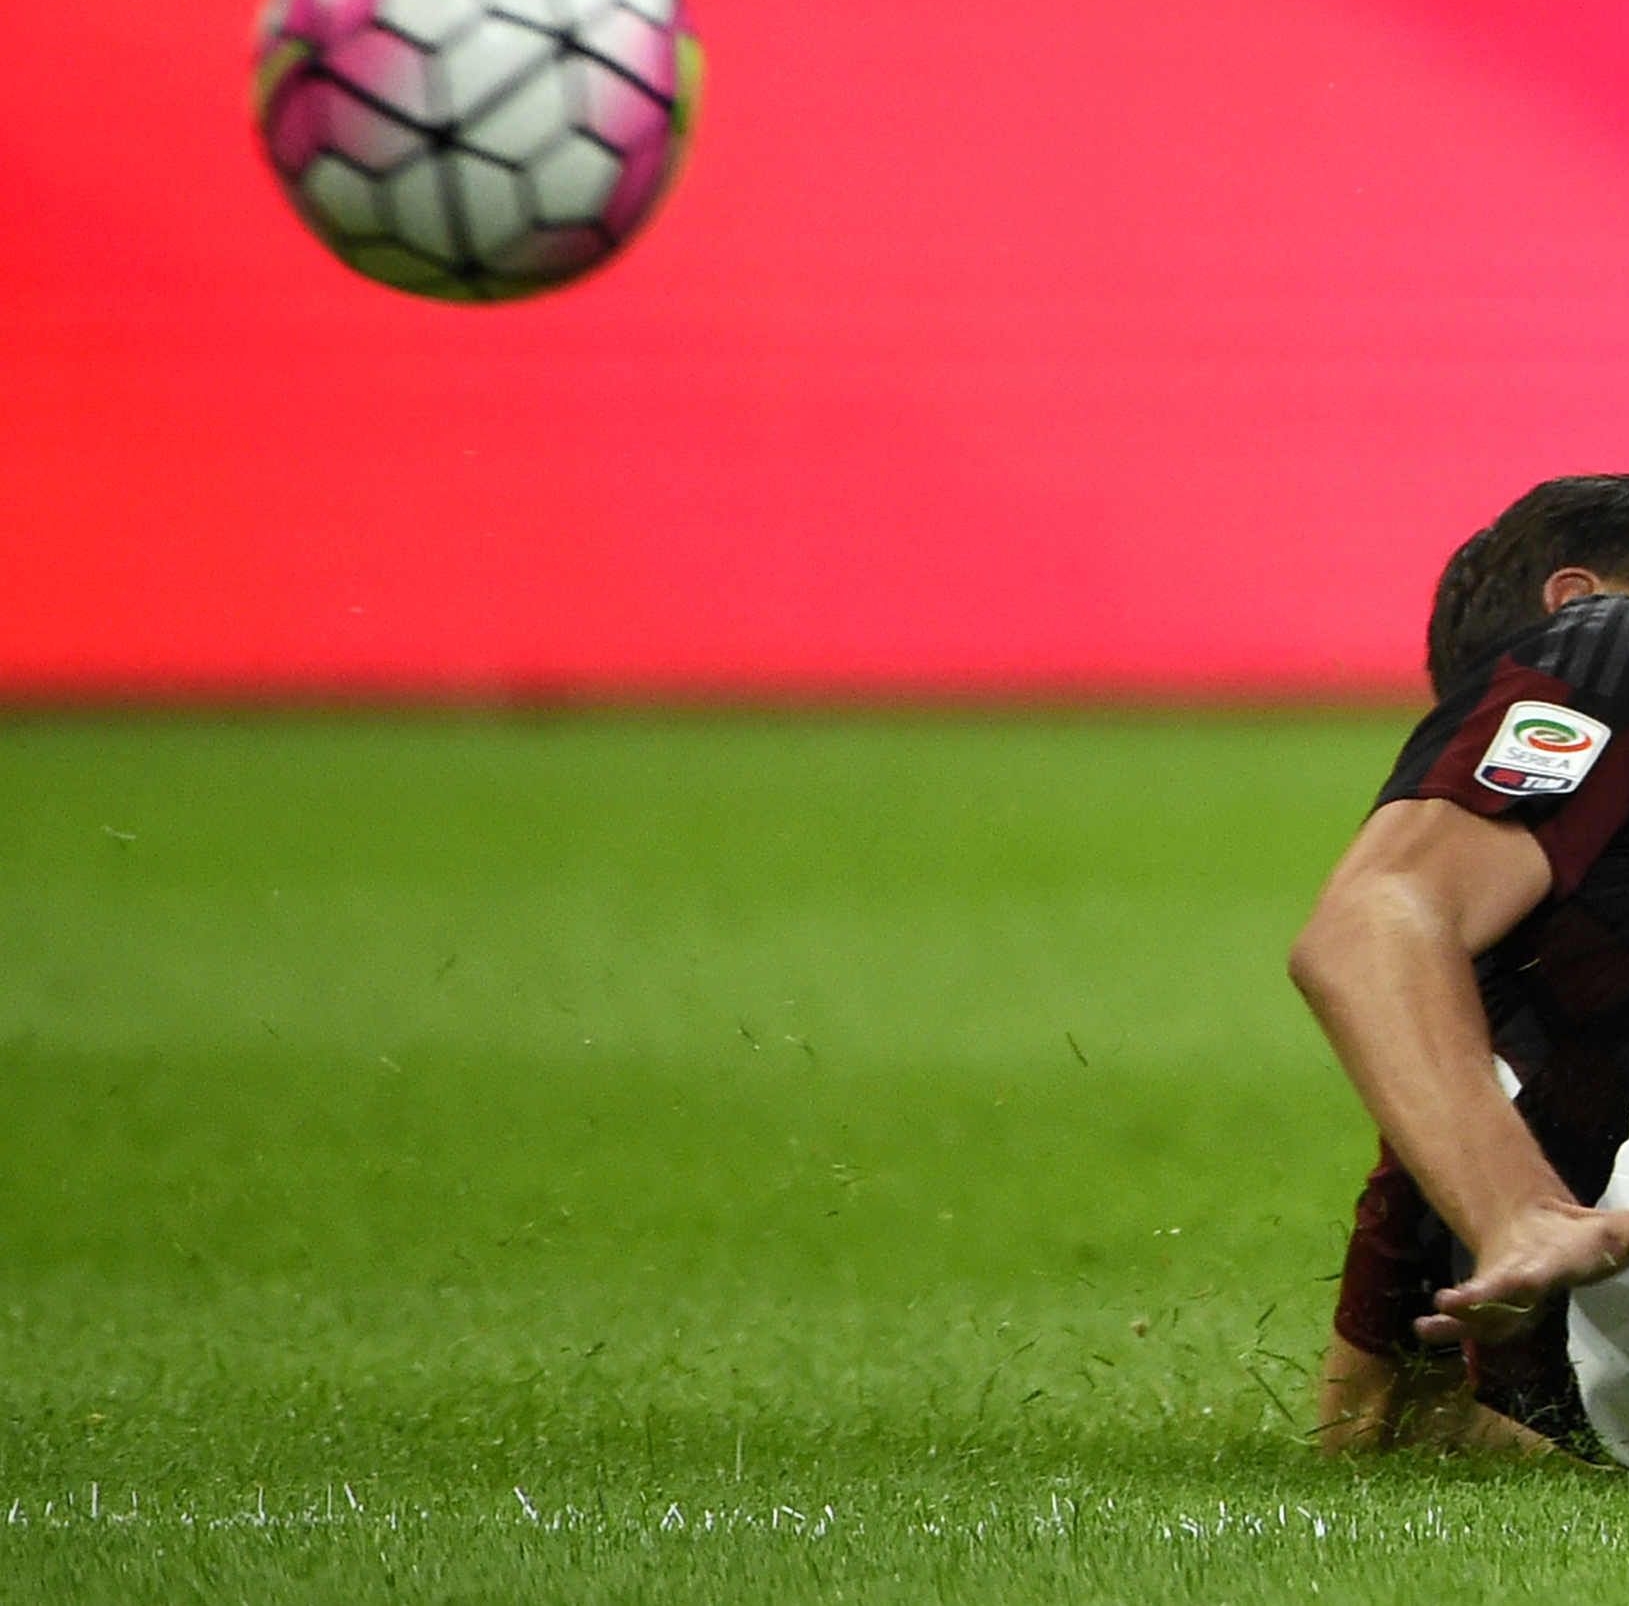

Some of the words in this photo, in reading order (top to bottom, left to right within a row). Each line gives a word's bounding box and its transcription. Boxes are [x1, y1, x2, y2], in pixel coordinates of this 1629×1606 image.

[1505, 746, 1557, 768] SERIE
[1557, 759, 1570, 770] A
[1521, 776, 1567, 790] TIM
